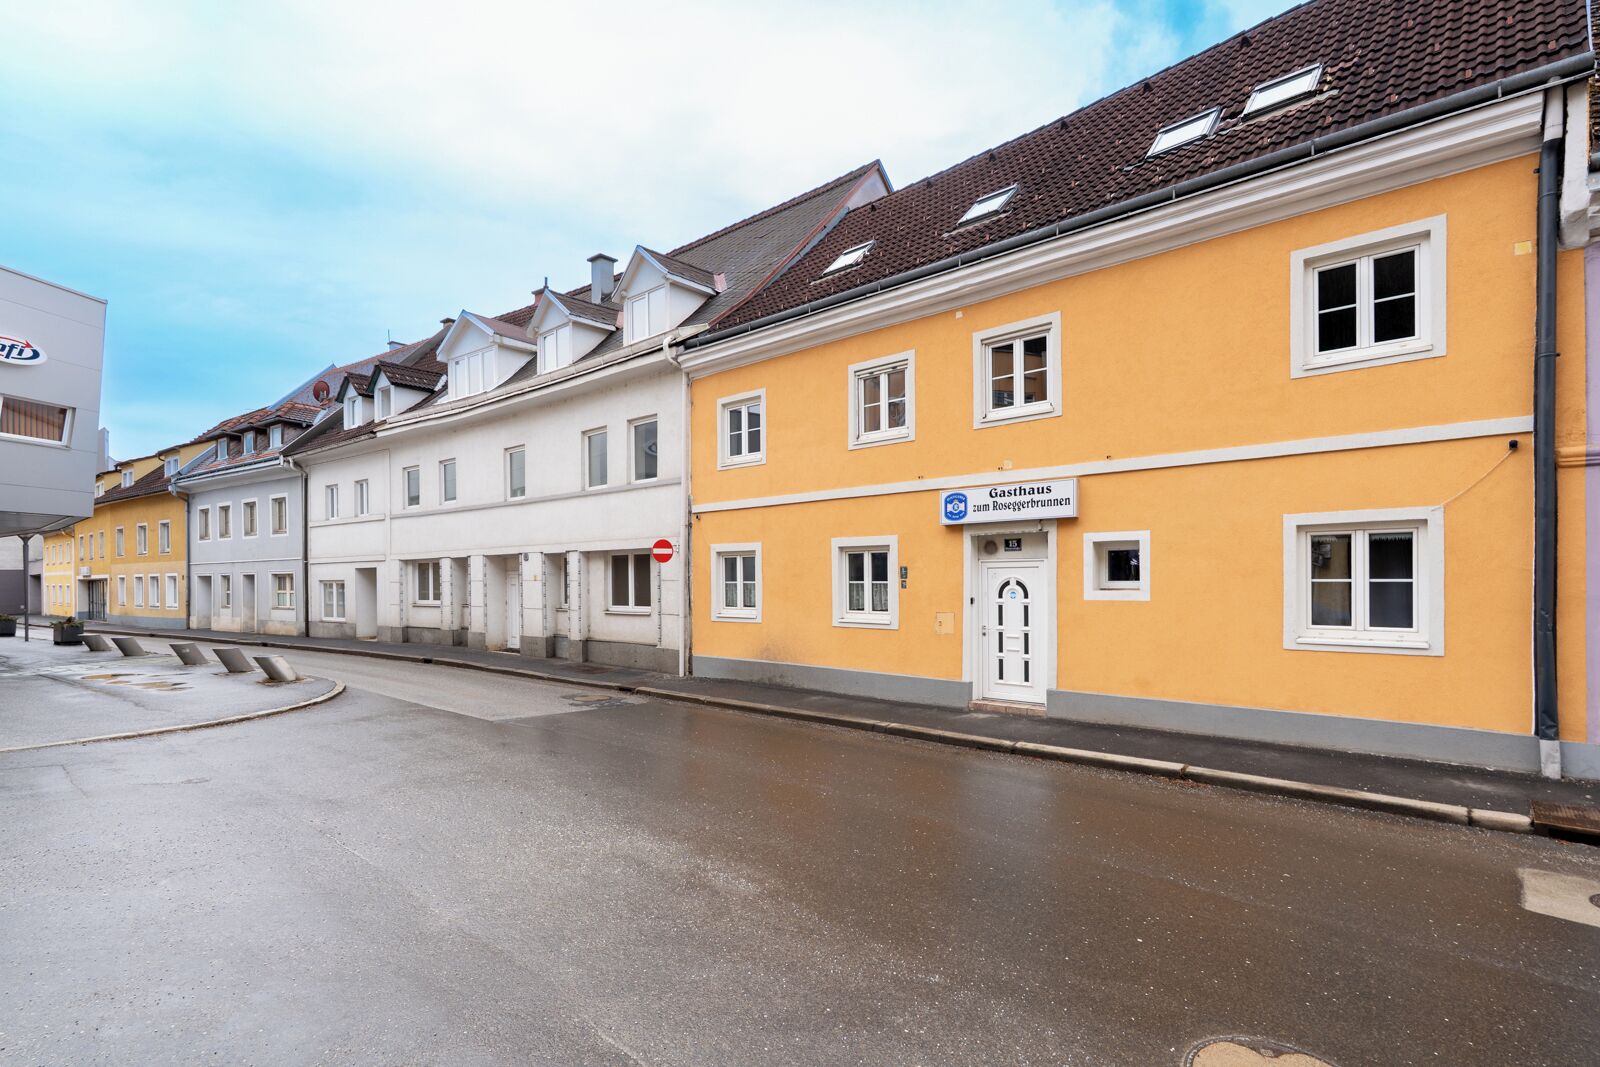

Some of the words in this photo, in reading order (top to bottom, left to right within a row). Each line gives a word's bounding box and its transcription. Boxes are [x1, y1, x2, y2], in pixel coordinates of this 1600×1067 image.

[989, 485, 1052, 498] Gasthaus
[973, 503, 990, 512] zum
[993, 497, 1070, 512] Roseggerbrunnen
